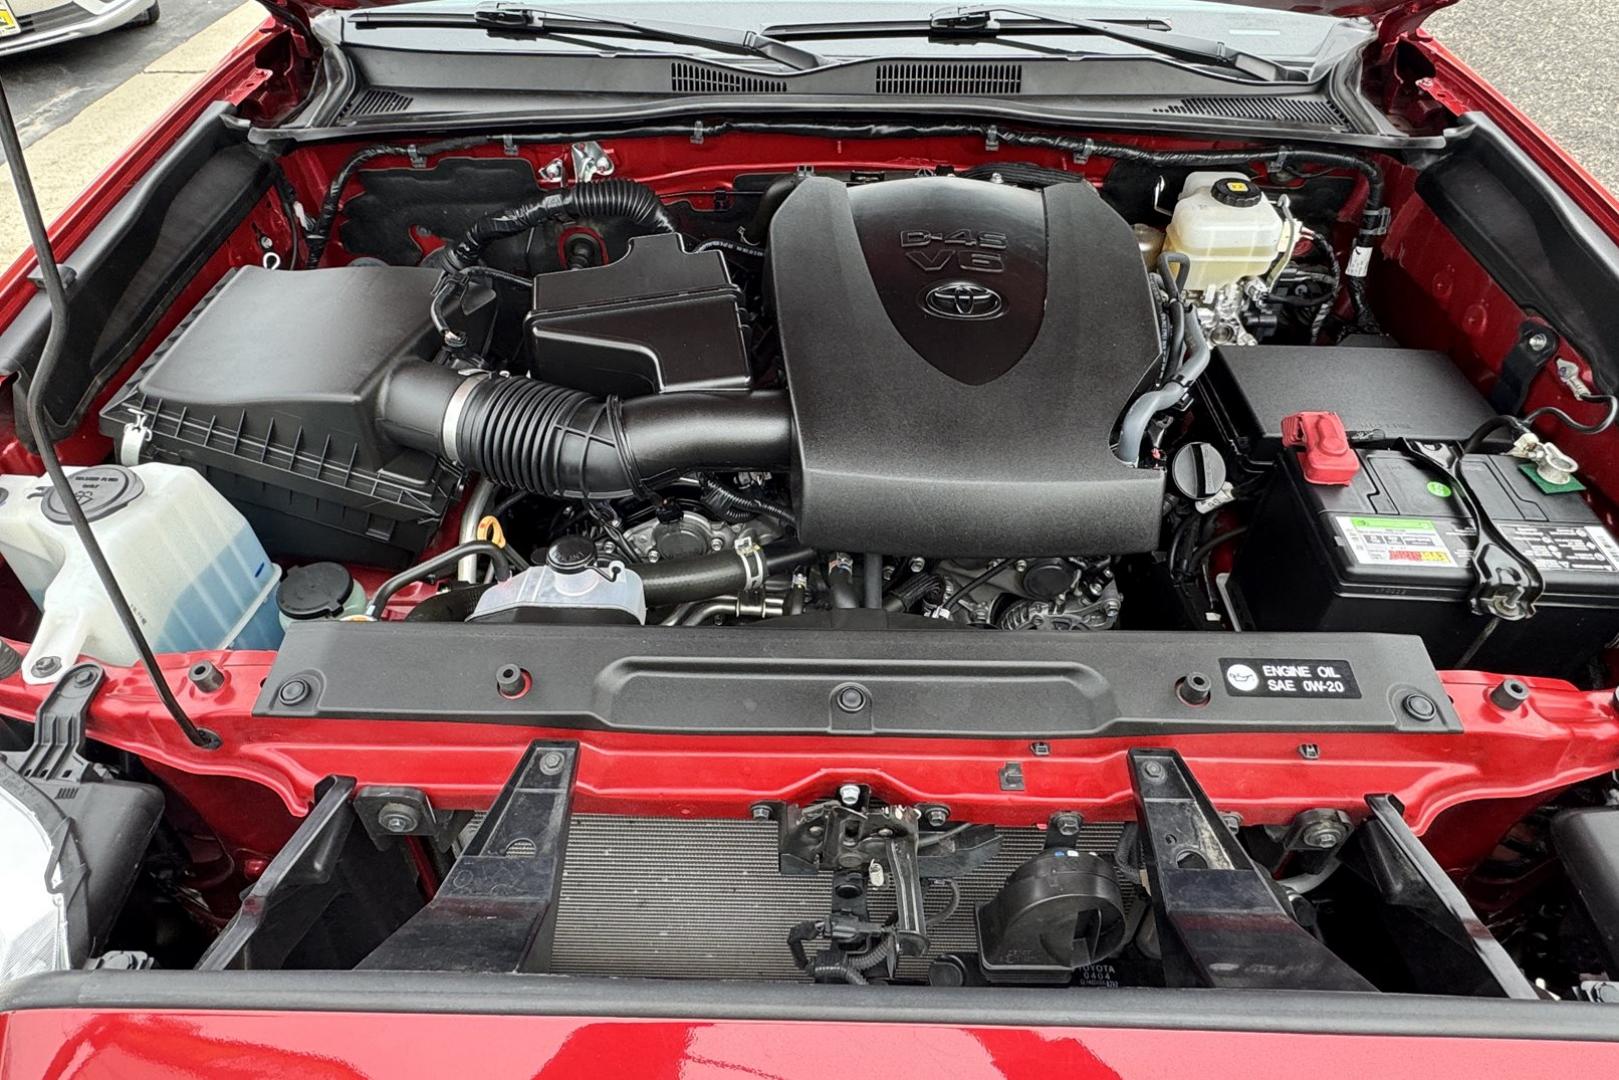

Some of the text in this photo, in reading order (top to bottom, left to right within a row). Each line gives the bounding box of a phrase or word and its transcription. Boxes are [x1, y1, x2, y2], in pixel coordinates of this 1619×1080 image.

[901, 229, 1007, 248] D-4S
[905, 249, 1005, 273] V6
[1262, 665, 1341, 678] ENGINE OIL
[1267, 679, 1345, 692] SAE 0W-20
